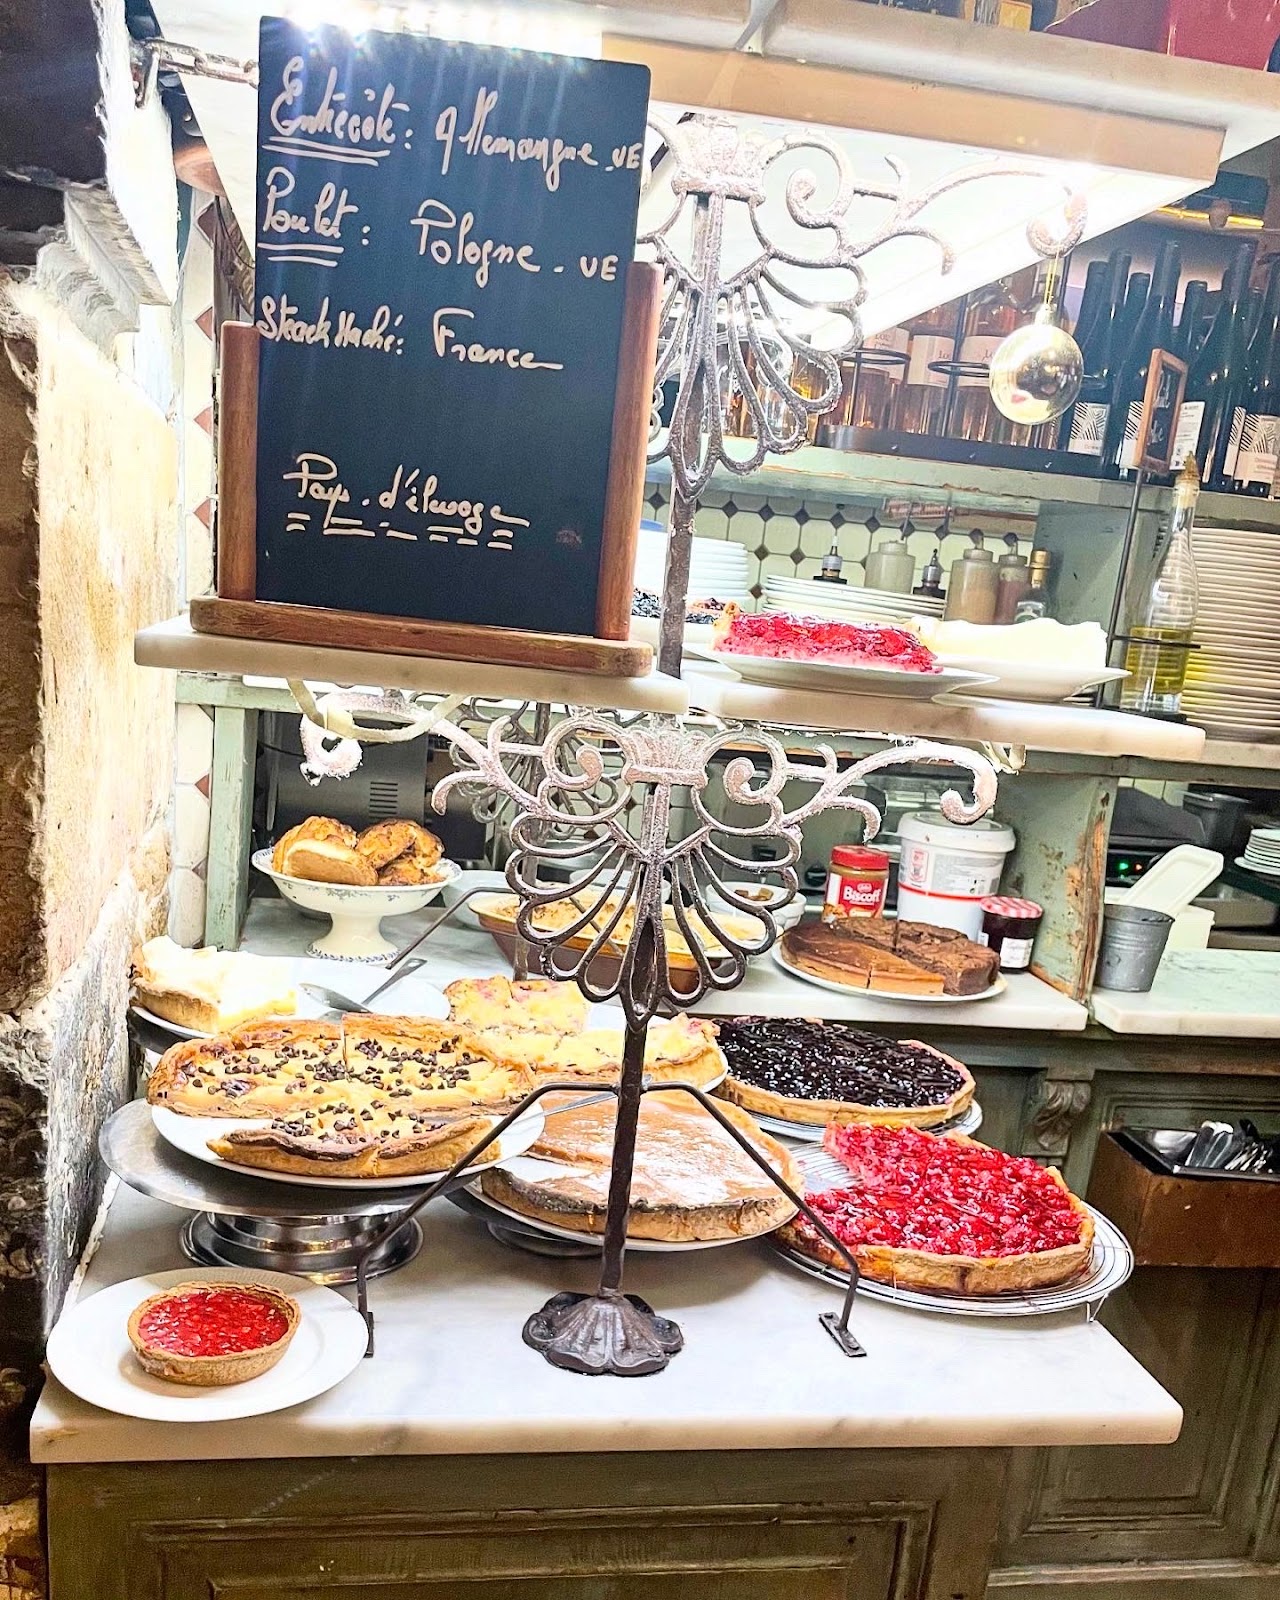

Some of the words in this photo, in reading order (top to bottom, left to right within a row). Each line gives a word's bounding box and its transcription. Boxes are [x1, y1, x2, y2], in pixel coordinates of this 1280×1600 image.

[410, 199, 541, 288] Pologne
[433, 307, 564, 370] France
[843, 885, 881, 904] Biscoff
